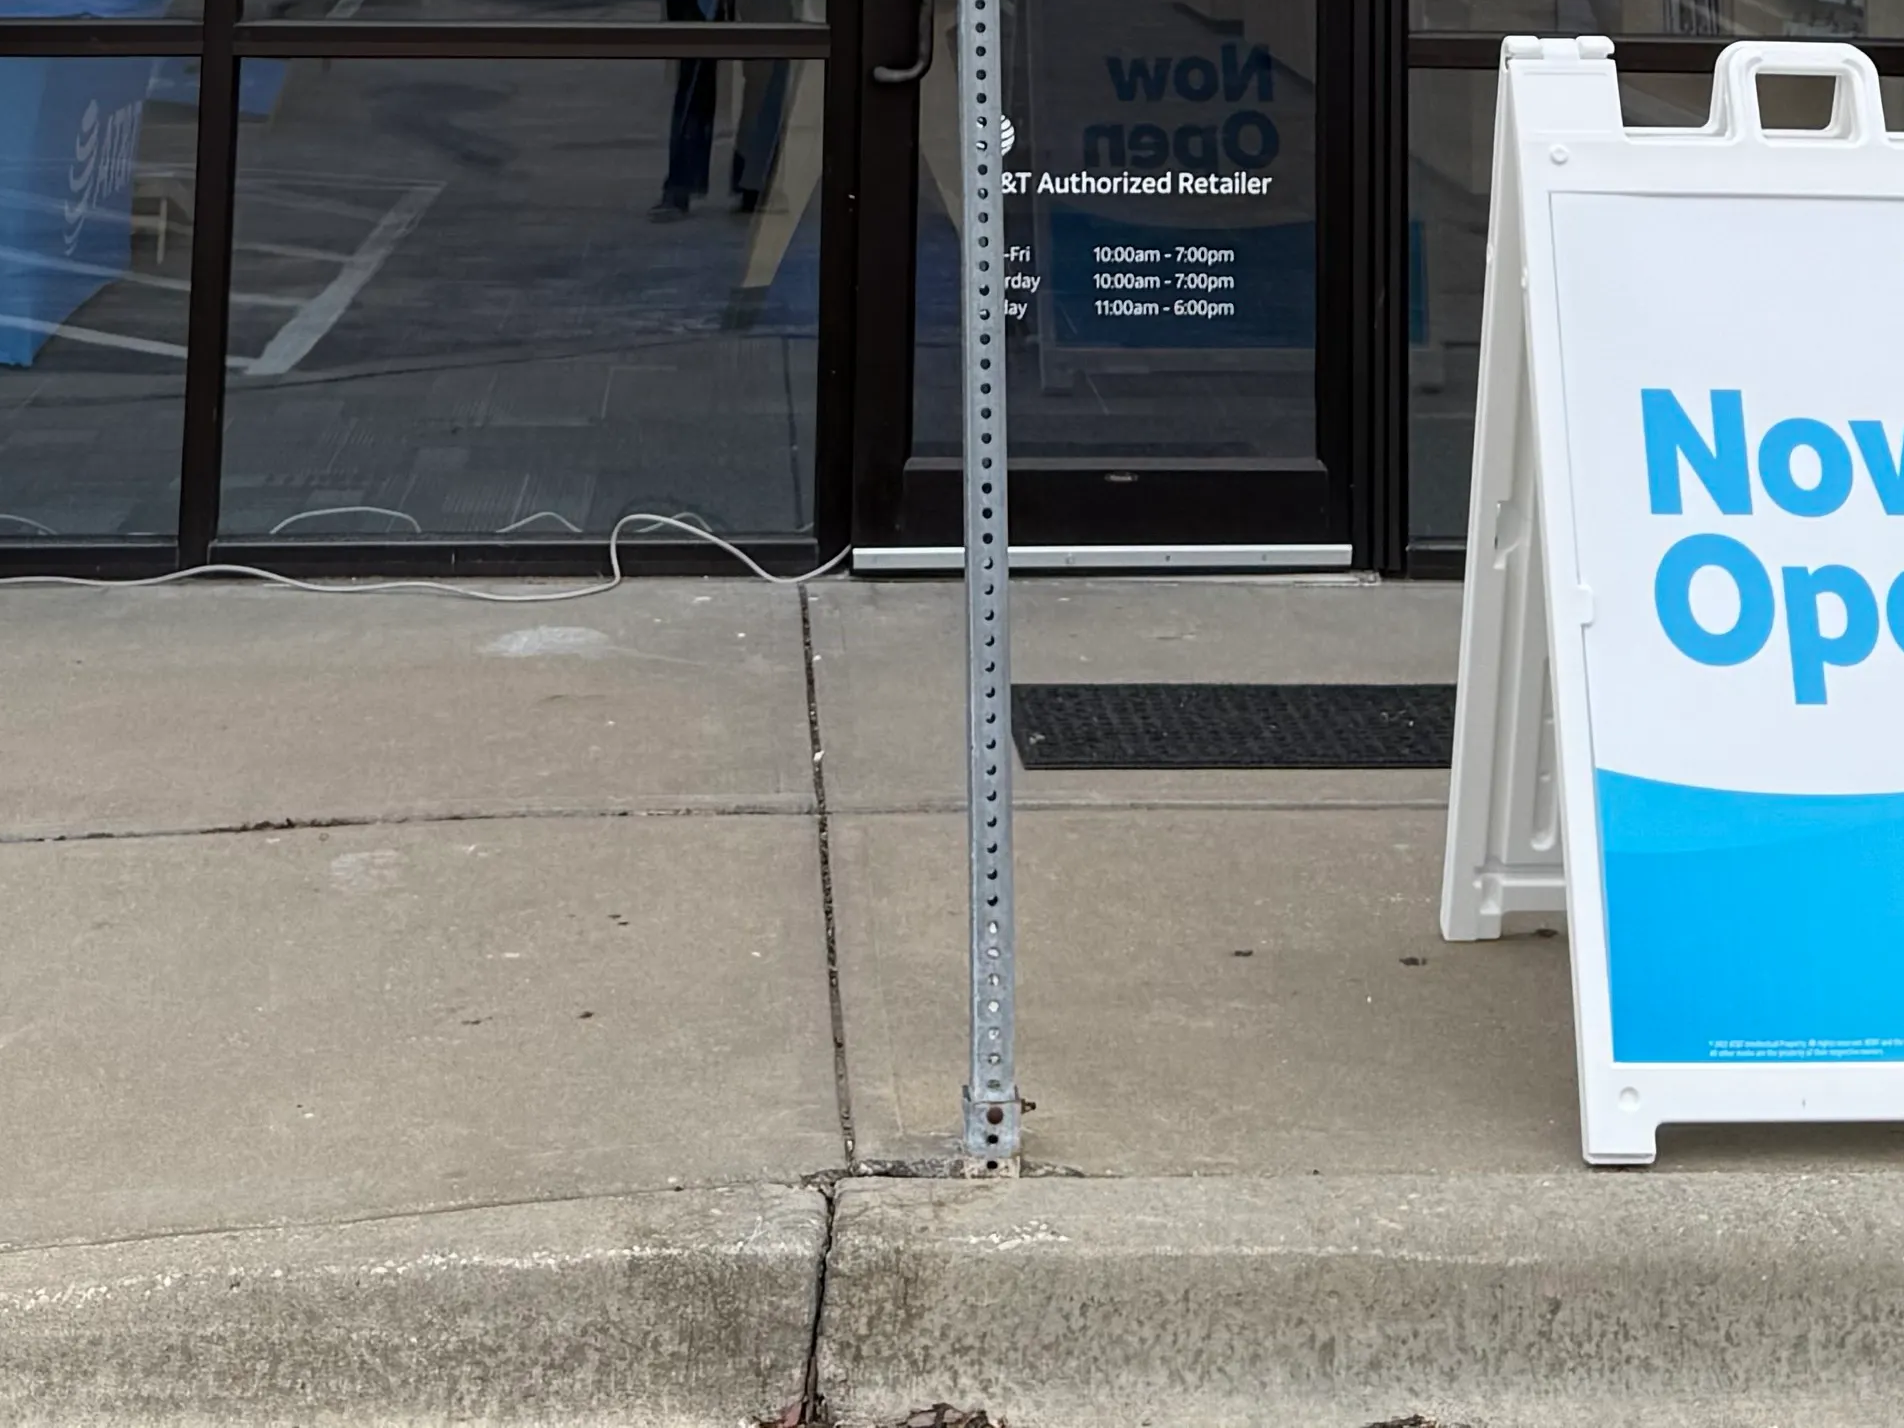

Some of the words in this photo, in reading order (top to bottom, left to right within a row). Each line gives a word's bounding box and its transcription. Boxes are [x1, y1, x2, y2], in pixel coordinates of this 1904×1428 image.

[1001, 172, 1031, 195] &T
[1037, 171, 1172, 195] Authorized
[1178, 171, 1272, 195] Retailer
[1003, 246, 1031, 263] -Fri
[1093, 246, 1161, 263] 10:00am
[1175, 246, 1235, 266] 7:00pm
[1093, 273, 1161, 290] 10:00am
[1175, 273, 1235, 292] 7:00pm
[1094, 299, 1160, 316] 11:00am
[1174, 299, 1235, 319] 6:00pm
